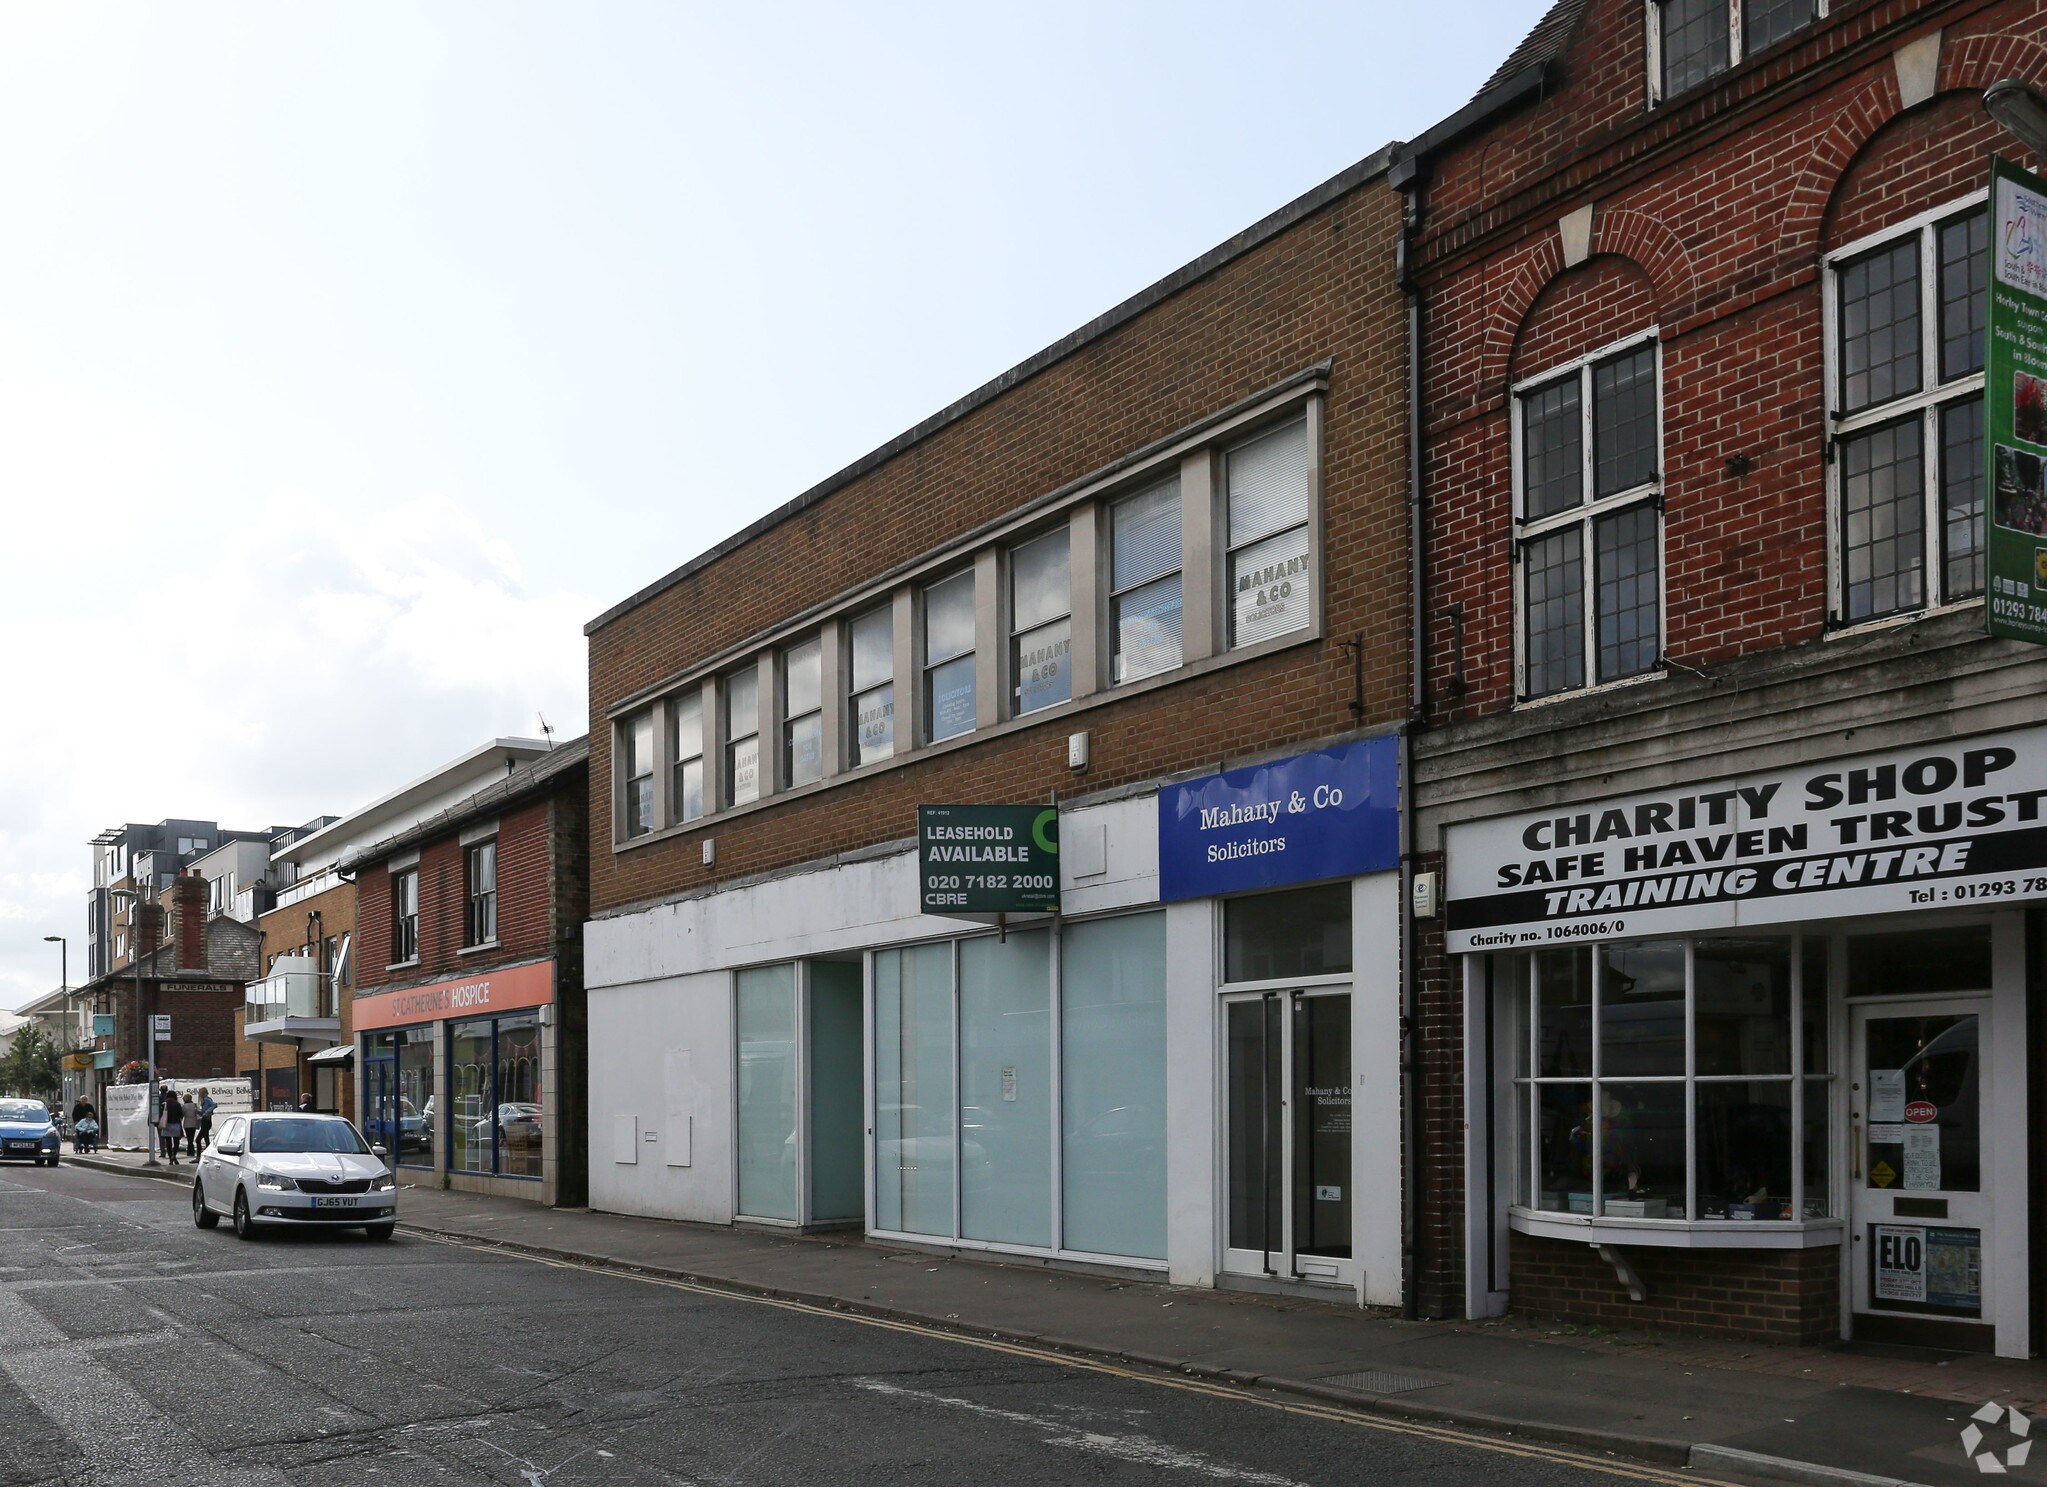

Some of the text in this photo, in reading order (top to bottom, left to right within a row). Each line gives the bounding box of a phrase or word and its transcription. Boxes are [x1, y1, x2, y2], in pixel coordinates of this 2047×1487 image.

[1996, 292, 2020, 313] Horley
[2021, 302, 2040, 318] Town
[1995, 325, 2017, 343] South
[2019, 334, 2026, 345] &
[2013, 348, 2022, 361] in
[1238, 553, 1309, 593] MAHANY
[1993, 597, 2047, 624] 01293 784
[1020, 639, 1071, 668] MAHANY
[1200, 784, 1343, 830] Mahany & Co
[1522, 747, 2017, 851] CHARITY SHOP
[927, 826, 1013, 840] LEASEHOLD
[1497, 789, 2047, 888] SAFE HAVEN TRUST
[928, 846, 1029, 862] AVAILABLE
[1207, 836, 1286, 863] Solicitors
[928, 875, 1053, 889] 020 7182 2000
[1544, 841, 1973, 915] TRAINING CENTRE
[1909, 887, 1936, 904] Tel
[1954, 881, 2016, 900] 01293
[2023, 877, 2047, 893] 78
[925, 893, 967, 905] CBRE
[1470, 920, 1625, 946] Charity no. 1064006/0
[451, 982, 490, 1008] HOSPICE
[1305, 1086, 1352, 1097] Mahany & Co
[1317, 1096, 1352, 1105] Solicitors
[1905, 1107, 1933, 1117] OPEN
[317, 1198, 358, 1207] GJ65 VUT
[1880, 1235, 1921, 1272] ELO
